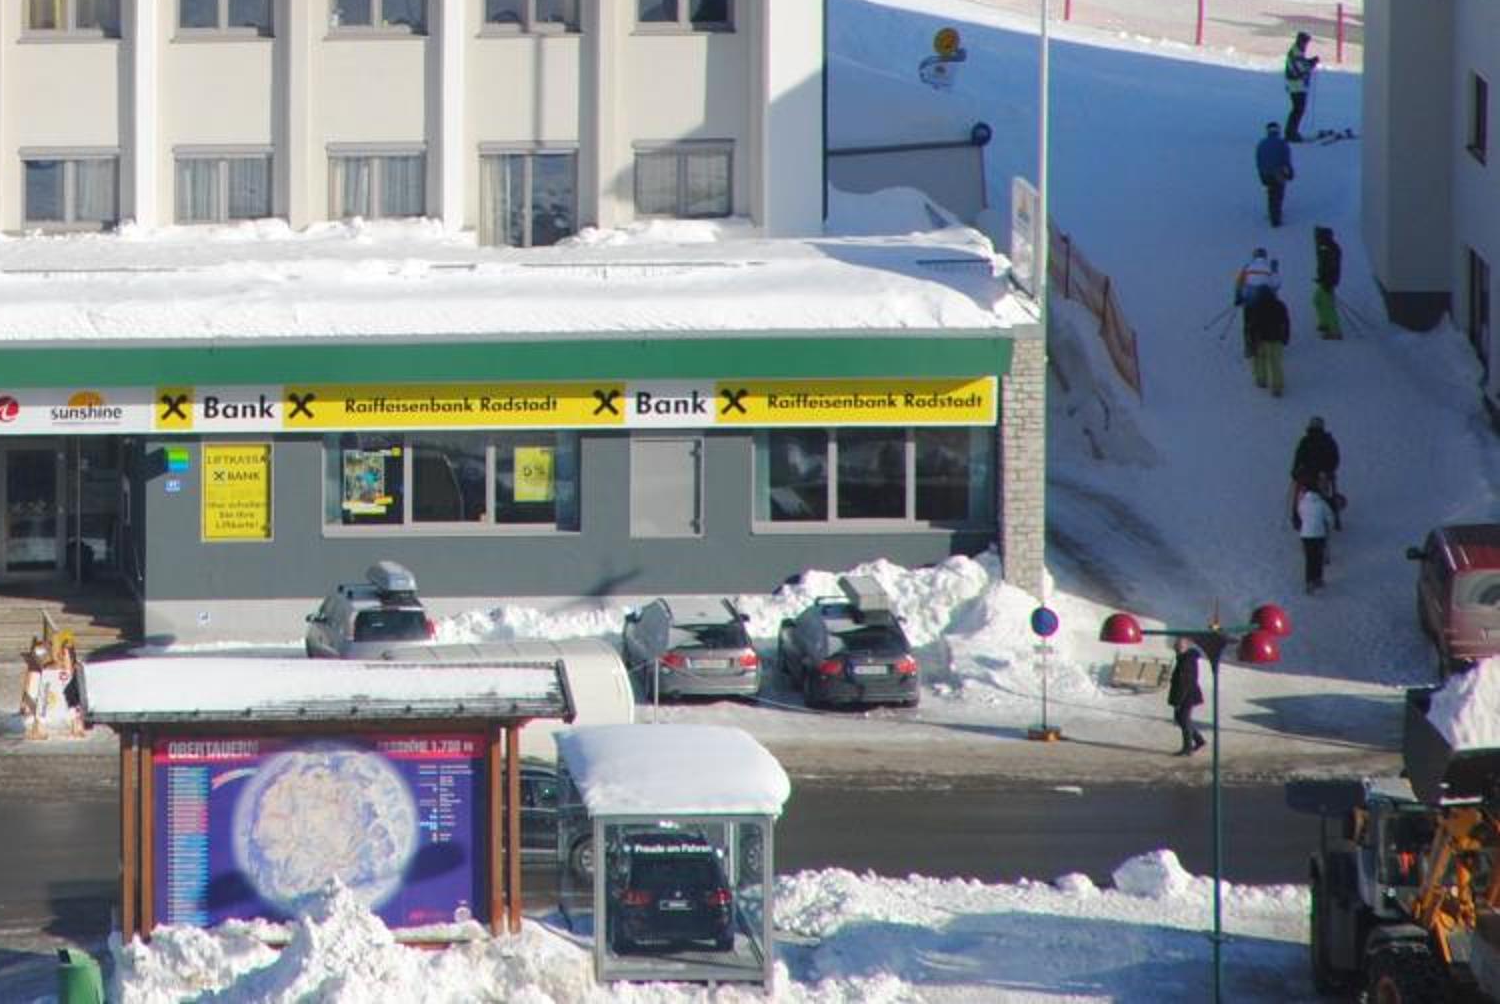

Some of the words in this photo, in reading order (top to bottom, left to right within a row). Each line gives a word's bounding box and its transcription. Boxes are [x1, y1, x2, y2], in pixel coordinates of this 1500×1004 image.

[50, 401, 122, 421] sunshine
[203, 393, 274, 419] Bank
[344, 396, 473, 414] Raiffeisenbank
[479, 395, 557, 412] Radstadt
[635, 390, 706, 415] Bank
[767, 392, 896, 410] Raiffeisenbank
[903, 392, 982, 409] Radstadt
